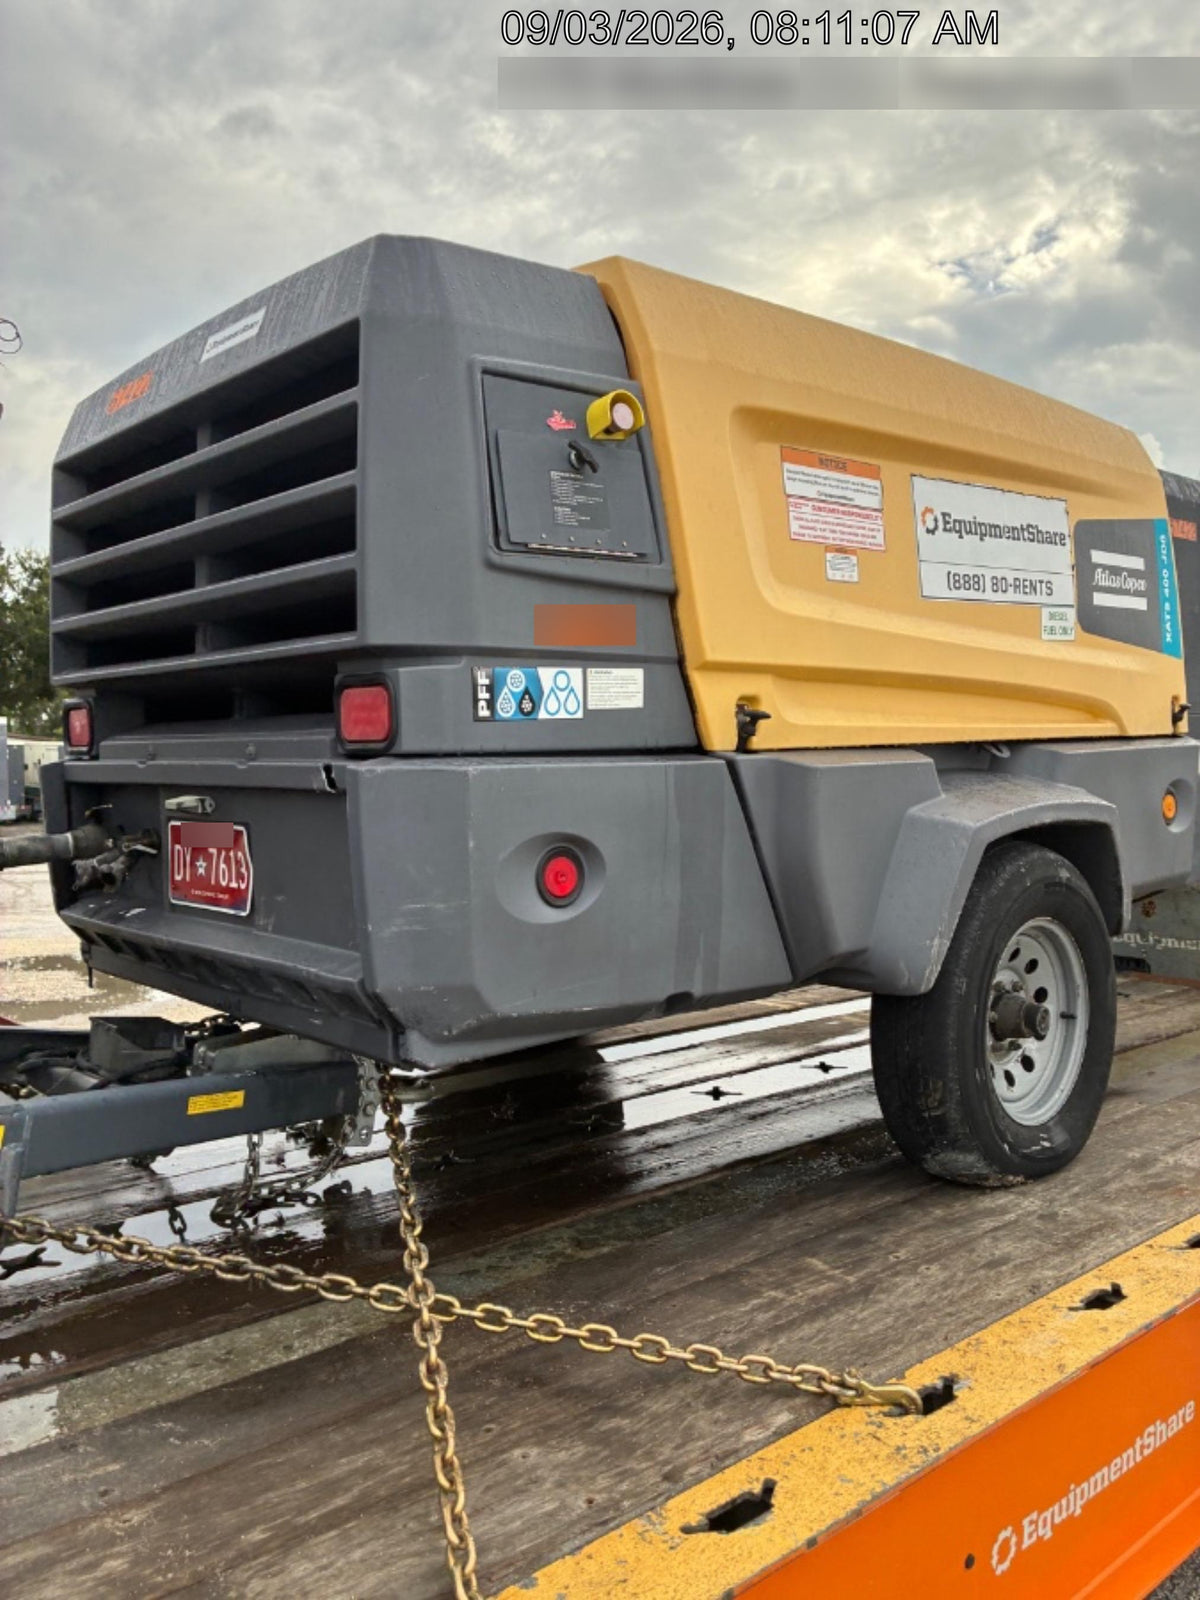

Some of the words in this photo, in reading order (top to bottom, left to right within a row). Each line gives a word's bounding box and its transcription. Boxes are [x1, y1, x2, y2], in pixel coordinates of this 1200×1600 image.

[941, 512, 1067, 546] EquipmentShare
[947, 571, 986, 593] (888)
[991, 576, 1054, 596] 80-RENTS
[1093, 568, 1121, 588] Atlas
[1121, 571, 1148, 594] Copco
[1162, 569, 1170, 598] 400
[1048, 610, 1068, 622] DIESEL
[477, 668, 491, 717] PFF
[173, 844, 192, 882] DY
[208, 847, 248, 890] 7613
[1021, 1399, 1196, 1551] EquipmentShare
